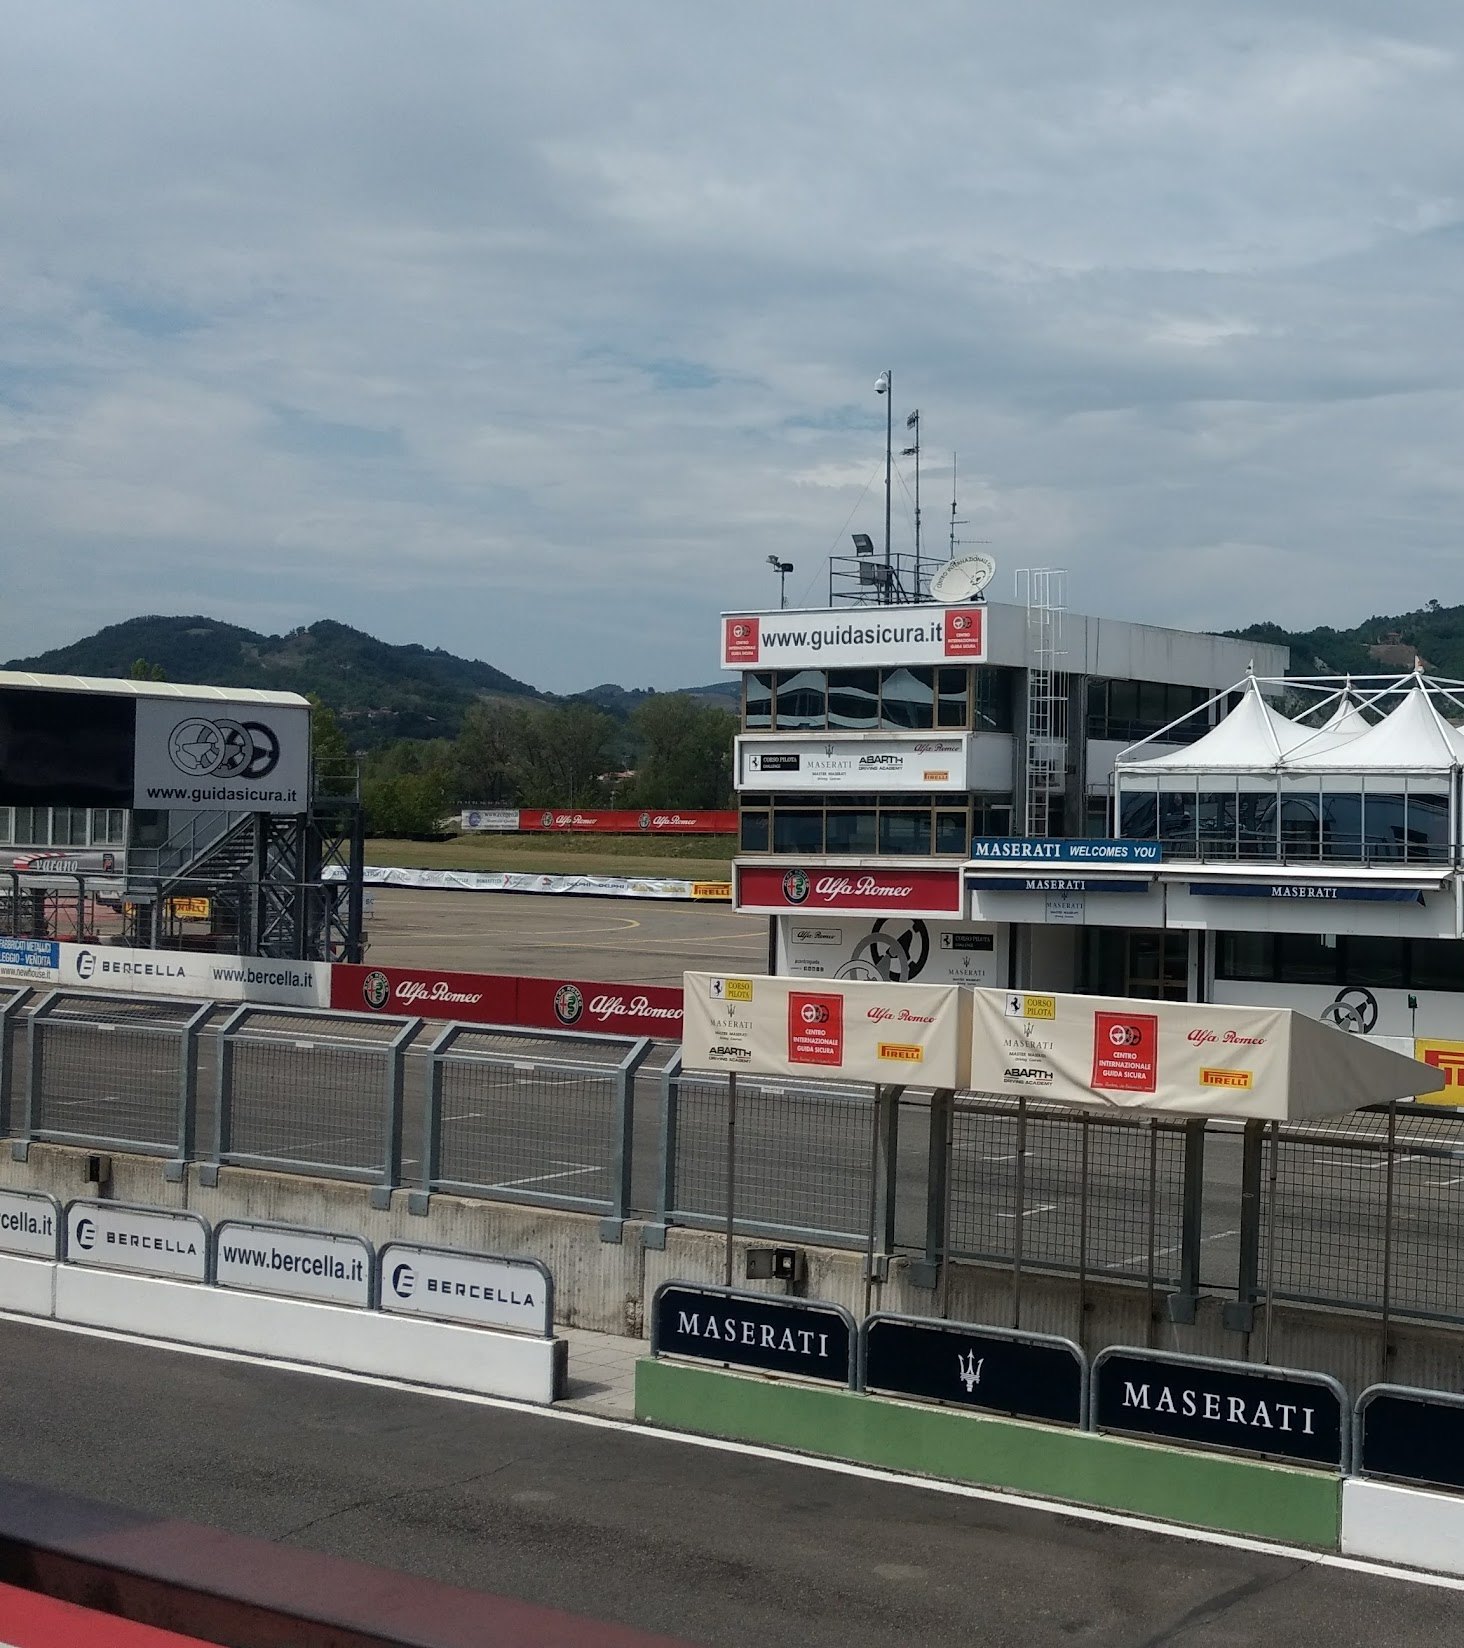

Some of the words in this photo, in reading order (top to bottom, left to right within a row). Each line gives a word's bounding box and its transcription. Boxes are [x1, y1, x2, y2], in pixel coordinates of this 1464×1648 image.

[761, 622, 943, 650] www.guidasicura.it
[914, 743, 932, 755] Alfa
[934, 743, 960, 752] Romeo
[807, 760, 852, 769] MASERATI
[859, 755, 903, 764] ABARTH
[923, 772, 949, 780] PIRELLI
[147, 786, 297, 802] www.guidasicura.it
[975, 842, 1061, 858] MASERATI
[1069, 845, 1129, 858] WELCOMES
[1134, 846, 1157, 859] YOU
[35, 859, 78, 872] varano
[693, 884, 729, 896] PIRELLI
[815, 876, 855, 901] Alfa
[855, 876, 913, 897] Romeo
[1025, 880, 1086, 890] MASERATI
[1271, 886, 1338, 899] MASERATI
[102, 961, 186, 977] BERCELLA
[213, 967, 313, 988] www.bercella.it
[728, 981, 750, 990] CORSO
[395, 980, 431, 1005] Alfa
[431, 981, 483, 1004] Romeo
[728, 991, 750, 999] PILOTA
[589, 995, 627, 1021] Alfa
[627, 996, 684, 1020] Romeo
[1027, 998, 1052, 1007] CORSO
[867, 1006, 895, 1024] Alfa
[897, 1009, 936, 1024] Romeo
[1027, 1008, 1052, 1017] PILOTA
[710, 1019, 753, 1029] MASERATI
[805, 1028, 826, 1036] CENTRO
[1187, 1028, 1219, 1046] Alfa
[1222, 1030, 1266, 1045] Romeo
[793, 1037, 839, 1045] INTERNAZIONALE
[1004, 1039, 1053, 1049] MASERATI
[709, 1046, 751, 1057] ABARTH
[881, 1045, 920, 1060] PIRELLI
[1113, 1051, 1137, 1059] CENTRO
[1099, 1060, 1151, 1070] INTERNAZIONALE
[1004, 1068, 1053, 1079] ABARTH
[1103, 1070, 1123, 1078] GUIDA
[1124, 1071, 1146, 1079] SICURA
[1203, 1071, 1249, 1086] PIRELLI
[106, 1231, 197, 1256] BERCELLA
[222, 1242, 364, 1282] www.bercella.it
[427, 1278, 535, 1307] BERCELLA
[676, 1310, 830, 1358] MASERATI
[1122, 1381, 1316, 1435] MASERATI
